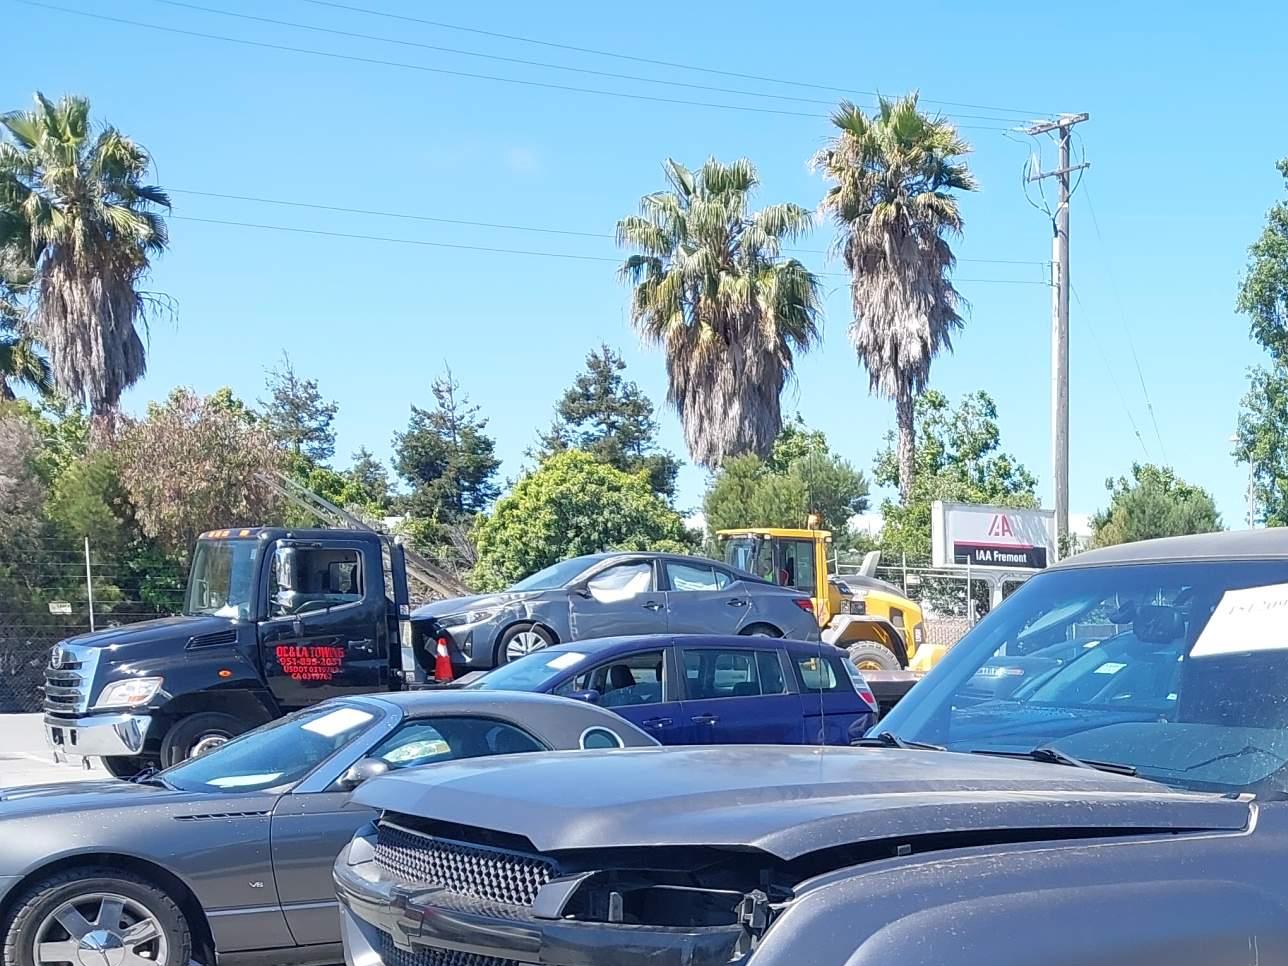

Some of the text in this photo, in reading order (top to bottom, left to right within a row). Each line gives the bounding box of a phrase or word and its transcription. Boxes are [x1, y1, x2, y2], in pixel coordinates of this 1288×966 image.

[975, 549, 1027, 563] IAA Fremont
[310, 646, 344, 658] TOWING
[283, 665, 308, 674] USDOT
[291, 673, 303, 681] CA
